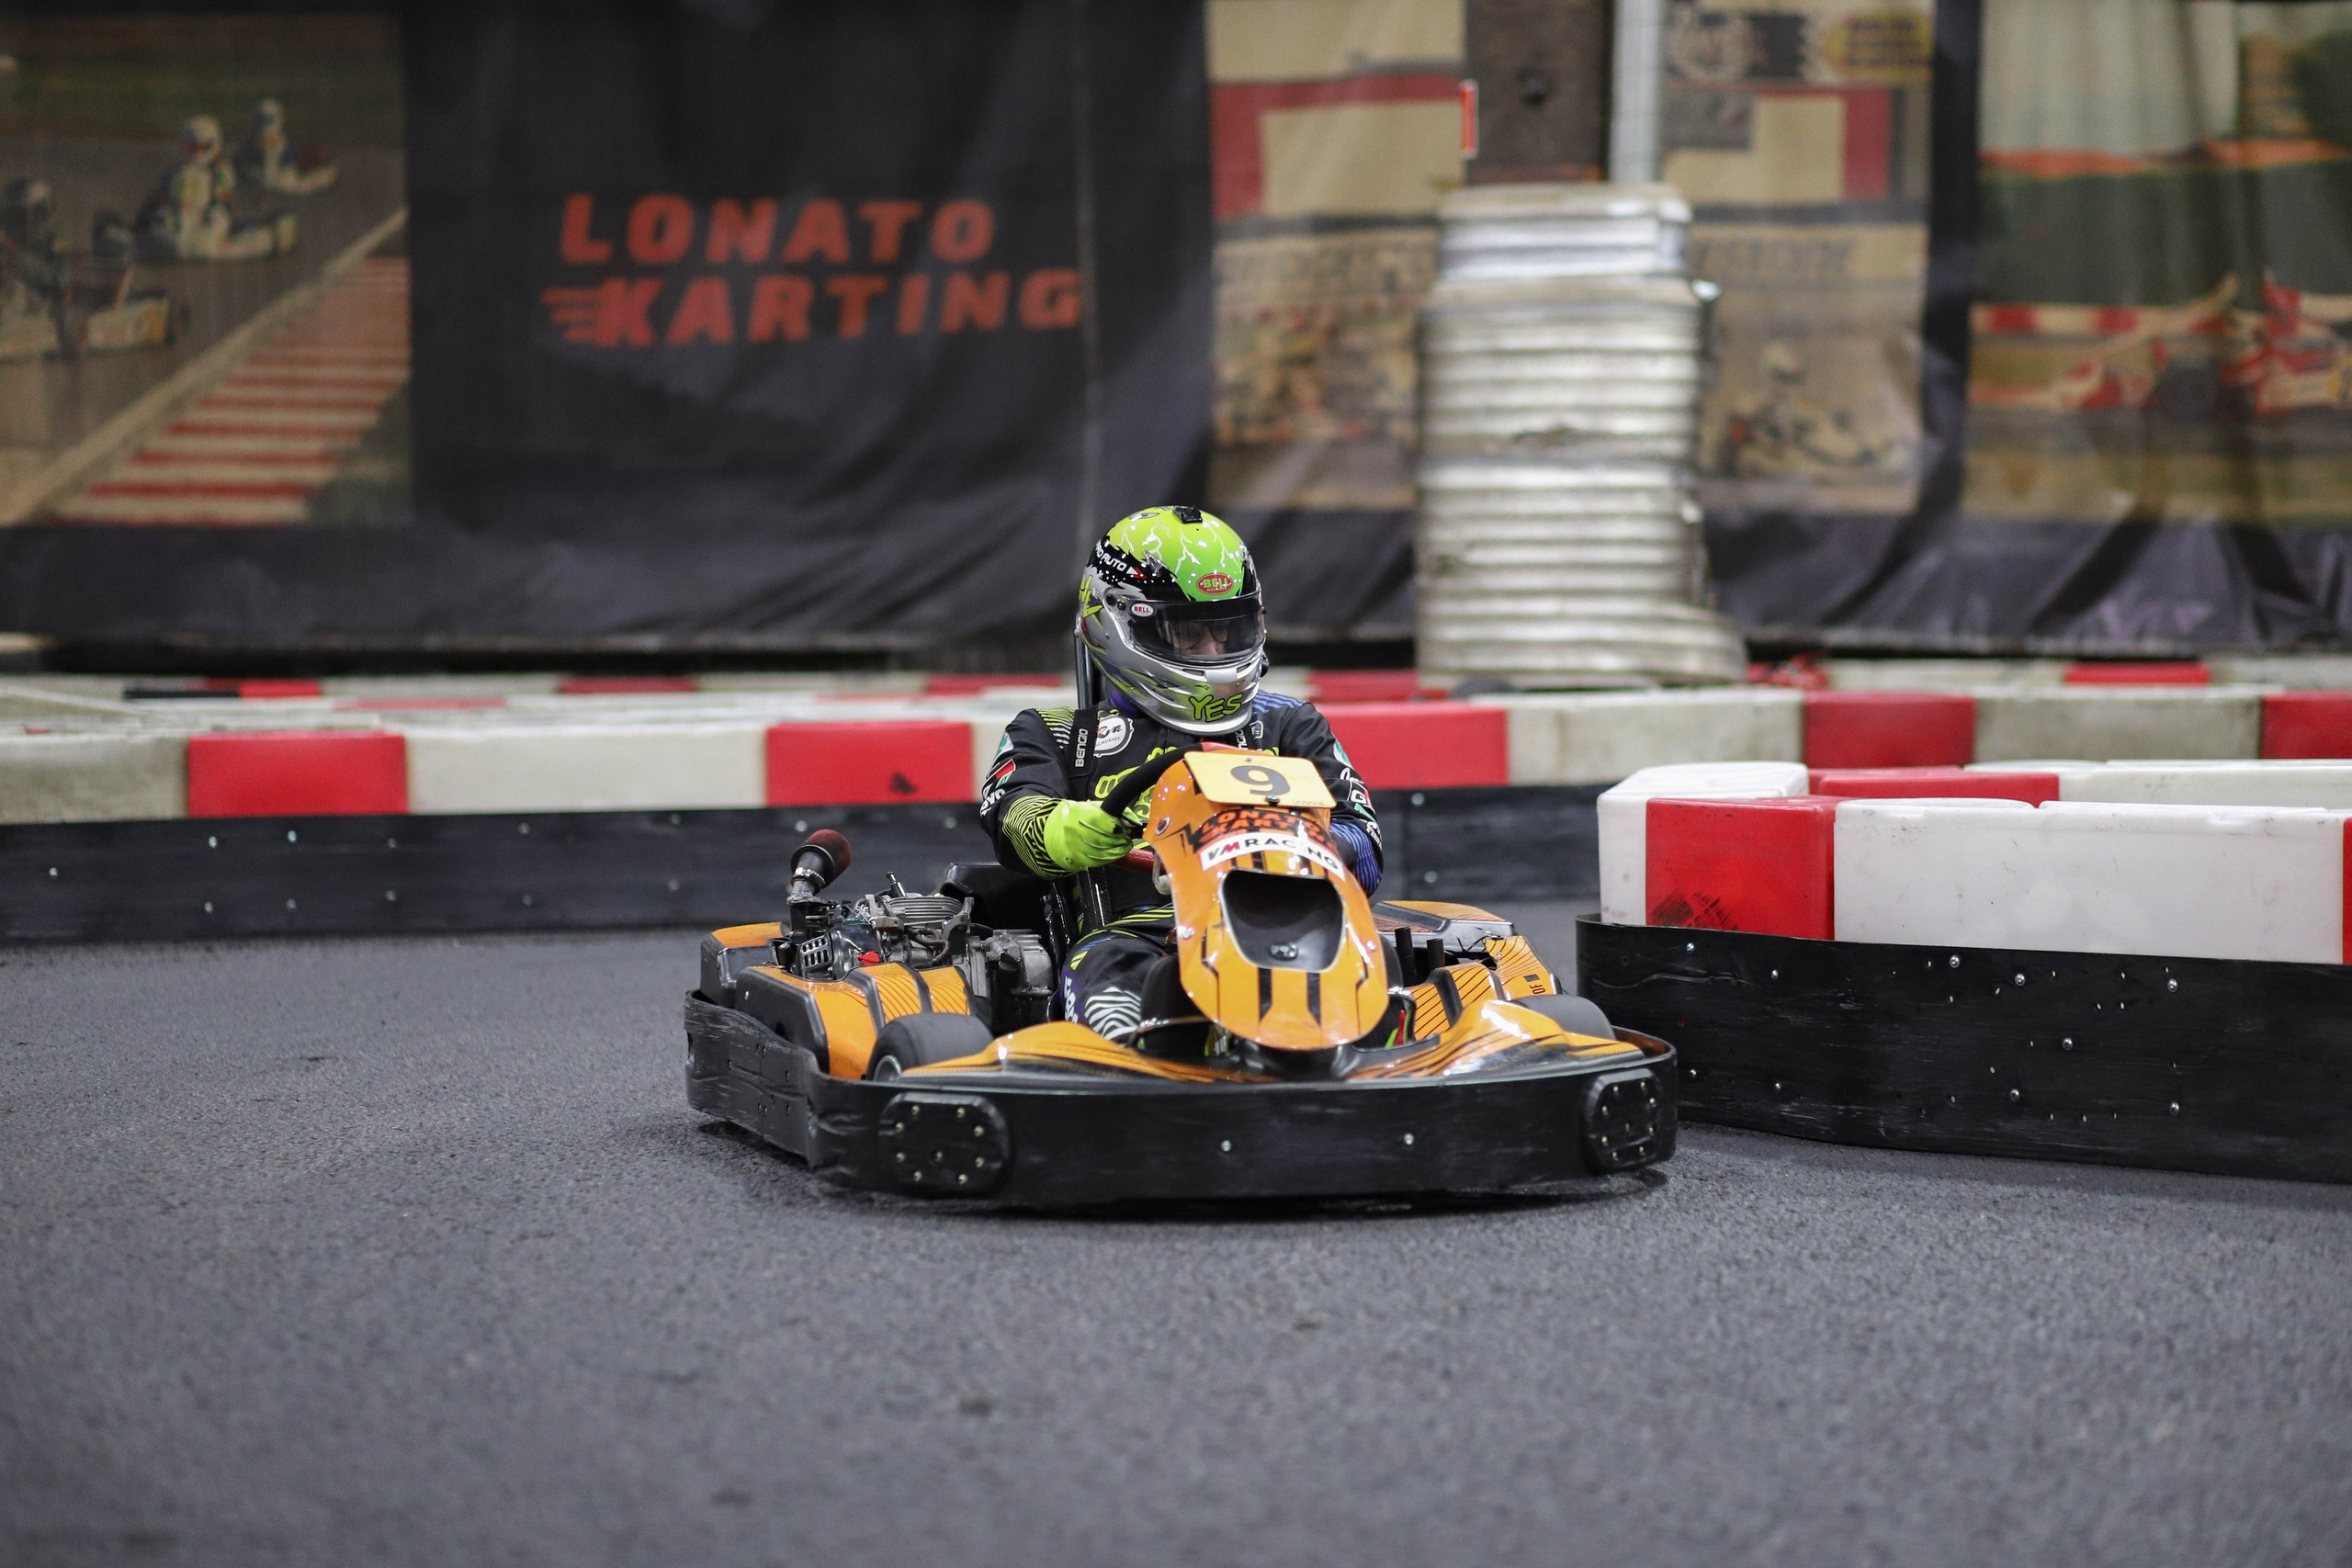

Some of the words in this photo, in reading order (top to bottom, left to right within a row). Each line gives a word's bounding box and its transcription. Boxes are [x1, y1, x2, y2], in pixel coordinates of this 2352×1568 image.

[559, 192, 996, 265] LONATO
[542, 267, 1083, 348] KARTING
[1101, 552, 1127, 571] AUTO
[1203, 578, 1231, 588] BELL
[1134, 605, 1150, 614] BELL
[1188, 693, 1244, 723] YES
[1075, 728, 1089, 767] BENGIO
[1229, 764, 1291, 796] 9
[1198, 818, 1338, 854] KARTNG
